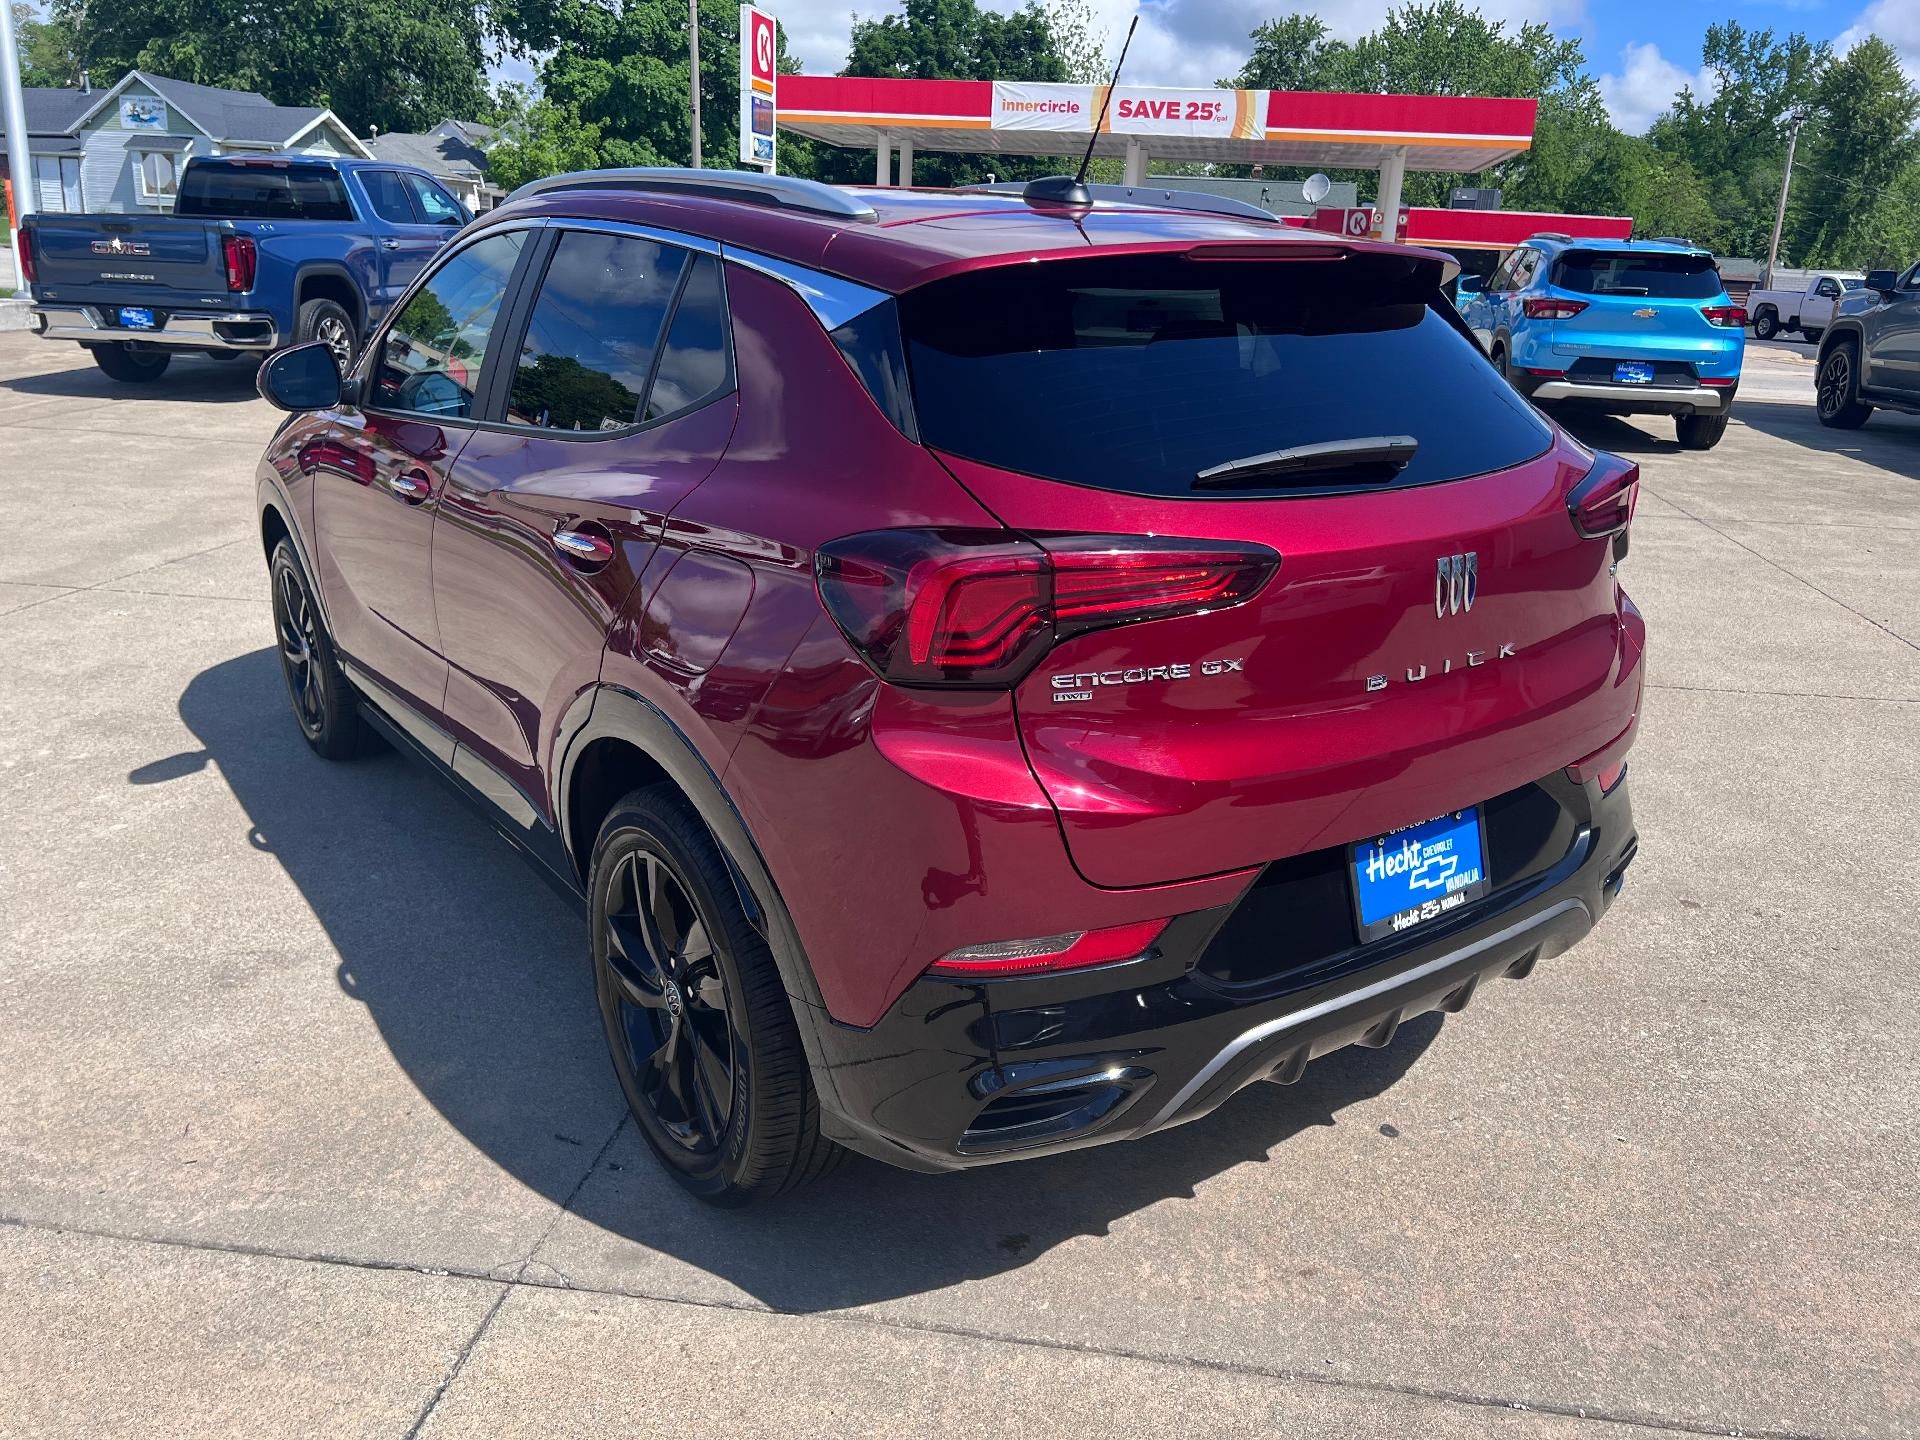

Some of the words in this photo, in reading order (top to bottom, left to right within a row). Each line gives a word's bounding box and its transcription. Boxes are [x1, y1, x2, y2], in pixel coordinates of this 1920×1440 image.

[761, 33, 771, 65] K
[1002, 99, 1080, 114] innercircle
[1118, 100, 1181, 120] SAVE
[1354, 216, 1366, 233] K
[91, 240, 150, 255] GMC
[1051, 663, 1191, 689] ENCORE
[1201, 658, 1244, 675] GX
[1366, 642, 1516, 692] BUICK
[1423, 838, 1453, 858] CHEVROLET
[1366, 839, 1422, 882] Hecht
[1445, 868, 1479, 892] VANDALIA
[1441, 892, 1465, 910] VANDALIA
[1393, 908, 1419, 931] Hecht
